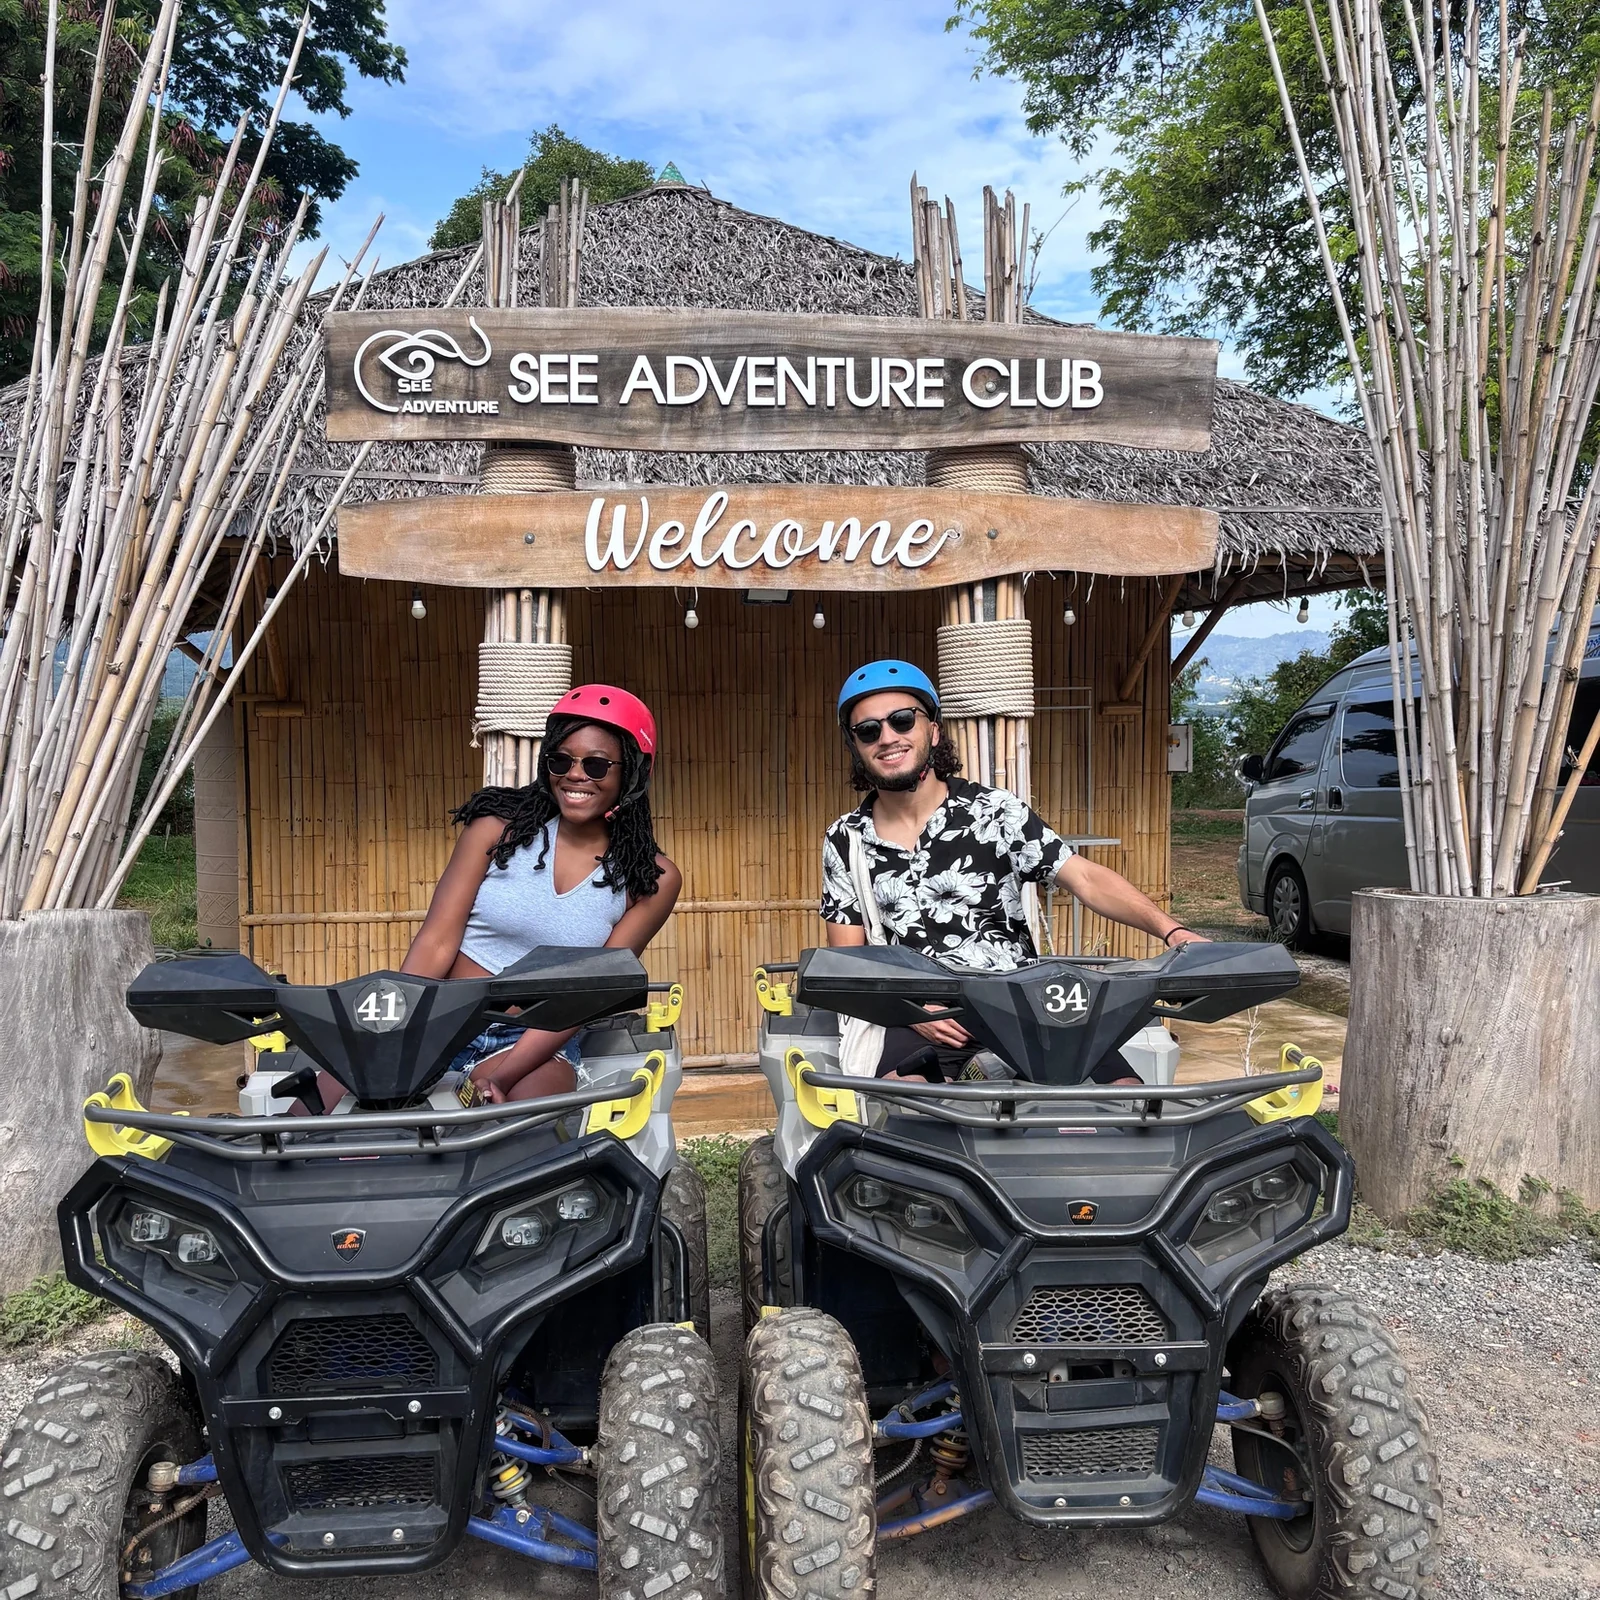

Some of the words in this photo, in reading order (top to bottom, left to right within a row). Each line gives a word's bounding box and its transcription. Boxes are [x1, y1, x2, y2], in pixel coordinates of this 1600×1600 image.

[397, 379, 433, 394] SEE
[508, 352, 599, 404] SEE
[618, 355, 945, 407] ADVENTURE
[962, 358, 1104, 408] CLUB
[402, 400, 500, 415] ADVENTURE
[585, 491, 952, 571] Welcome
[357, 991, 400, 1021] 41
[1045, 982, 1088, 1013] 34
